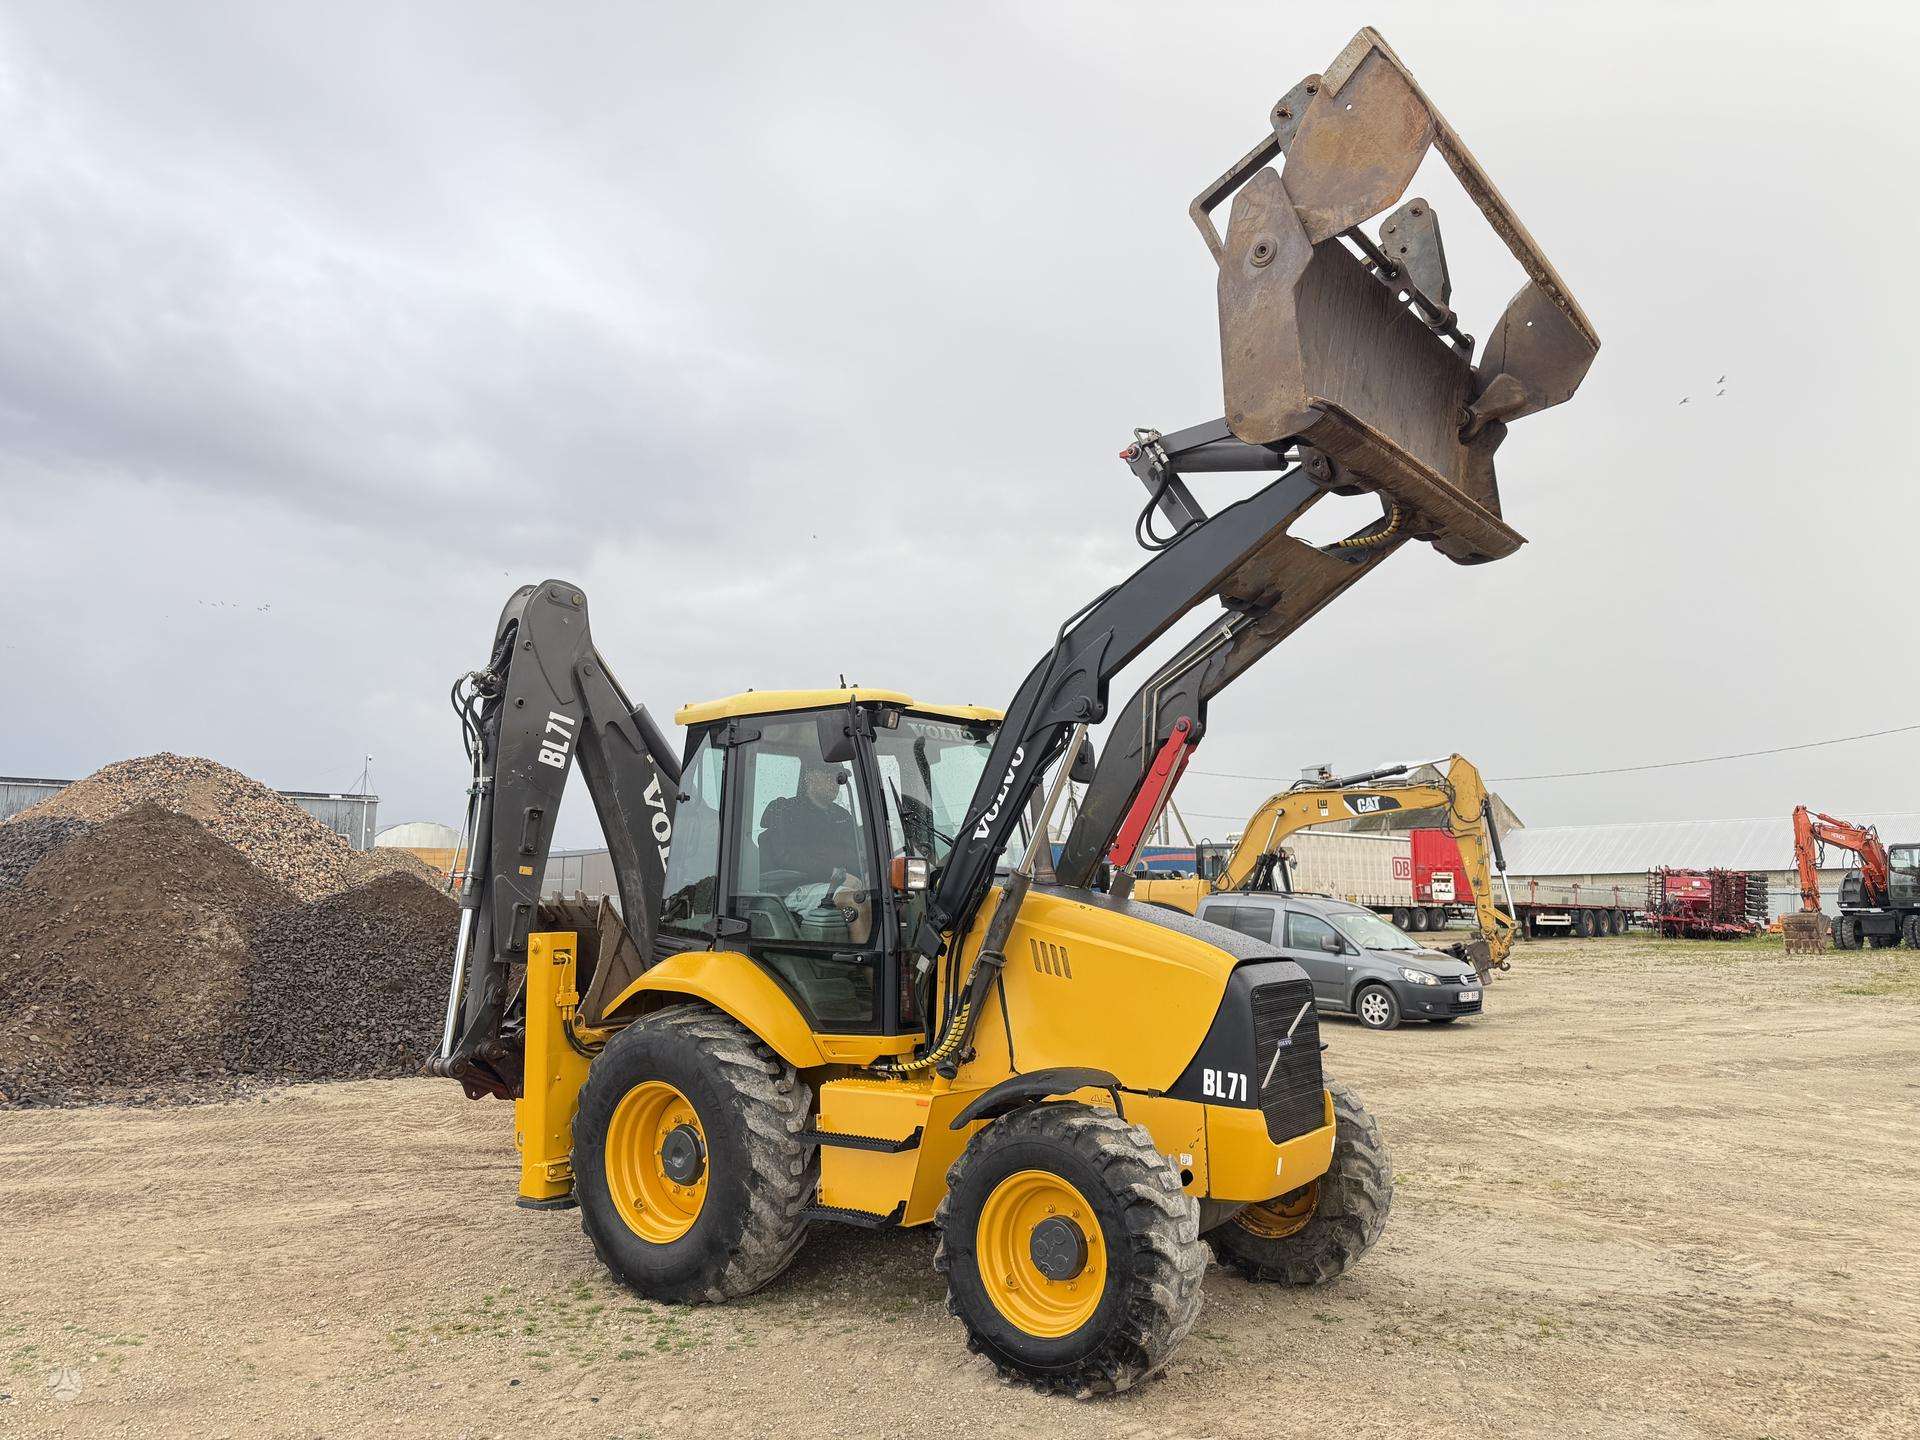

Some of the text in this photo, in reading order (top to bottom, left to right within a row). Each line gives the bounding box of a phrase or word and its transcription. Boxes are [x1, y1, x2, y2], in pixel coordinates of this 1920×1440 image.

[538, 711, 575, 770] BL71
[973, 746, 1024, 840] VOLVO
[1356, 796, 1380, 813] CAT
[1395, 860, 1410, 876] DB
[1202, 1068, 1247, 1101] BL71
